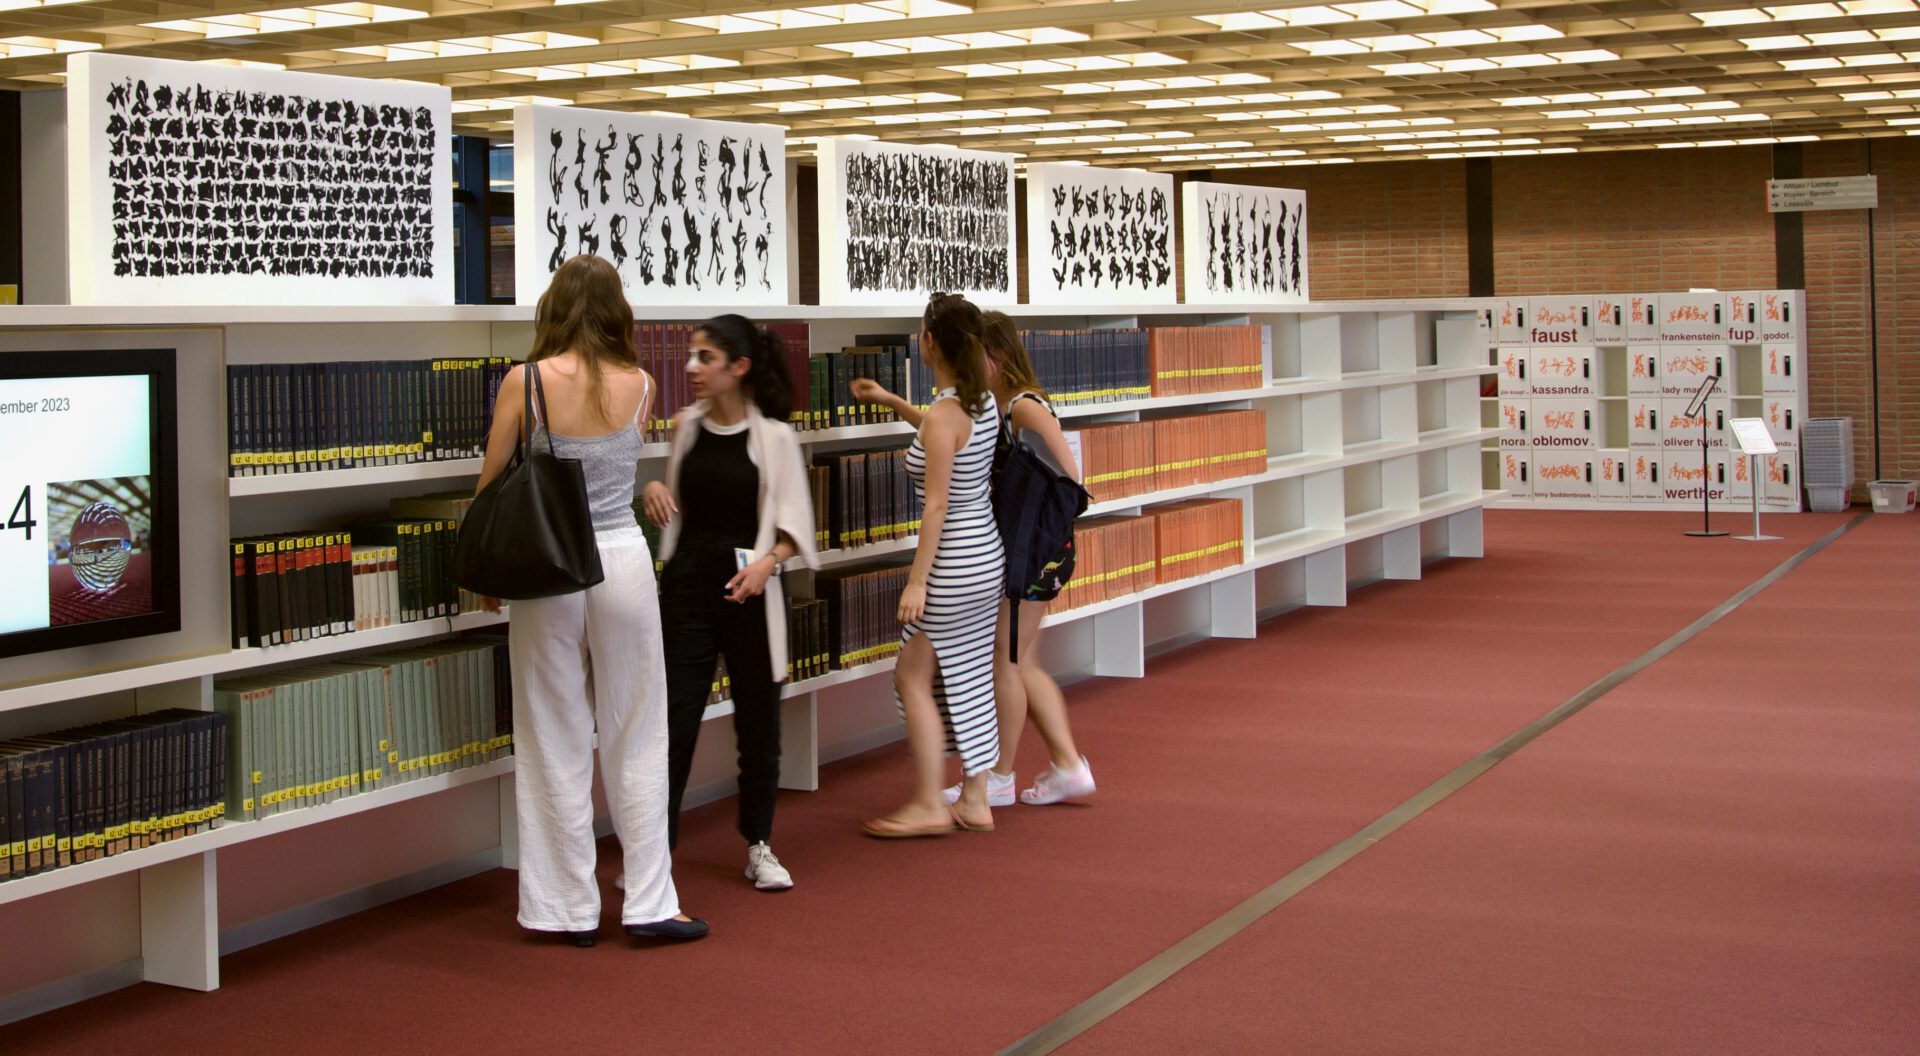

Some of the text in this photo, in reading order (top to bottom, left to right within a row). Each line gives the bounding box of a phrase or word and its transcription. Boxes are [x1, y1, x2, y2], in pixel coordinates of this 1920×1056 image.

[1531, 328, 1578, 342] faust
[1662, 333, 1720, 341] frankenstein
[1728, 328, 1754, 343] fup
[1763, 332, 1790, 341] godot
[1532, 385, 1589, 394] kassandra
[1662, 386, 1680, 395] lady
[42, 398, 70, 412] 2023
[1532, 436, 1589, 446] oblomov
[1664, 437, 1694, 446] oliver
[1664, 487, 1724, 499] werther
[0, 484, 37, 541] 4
